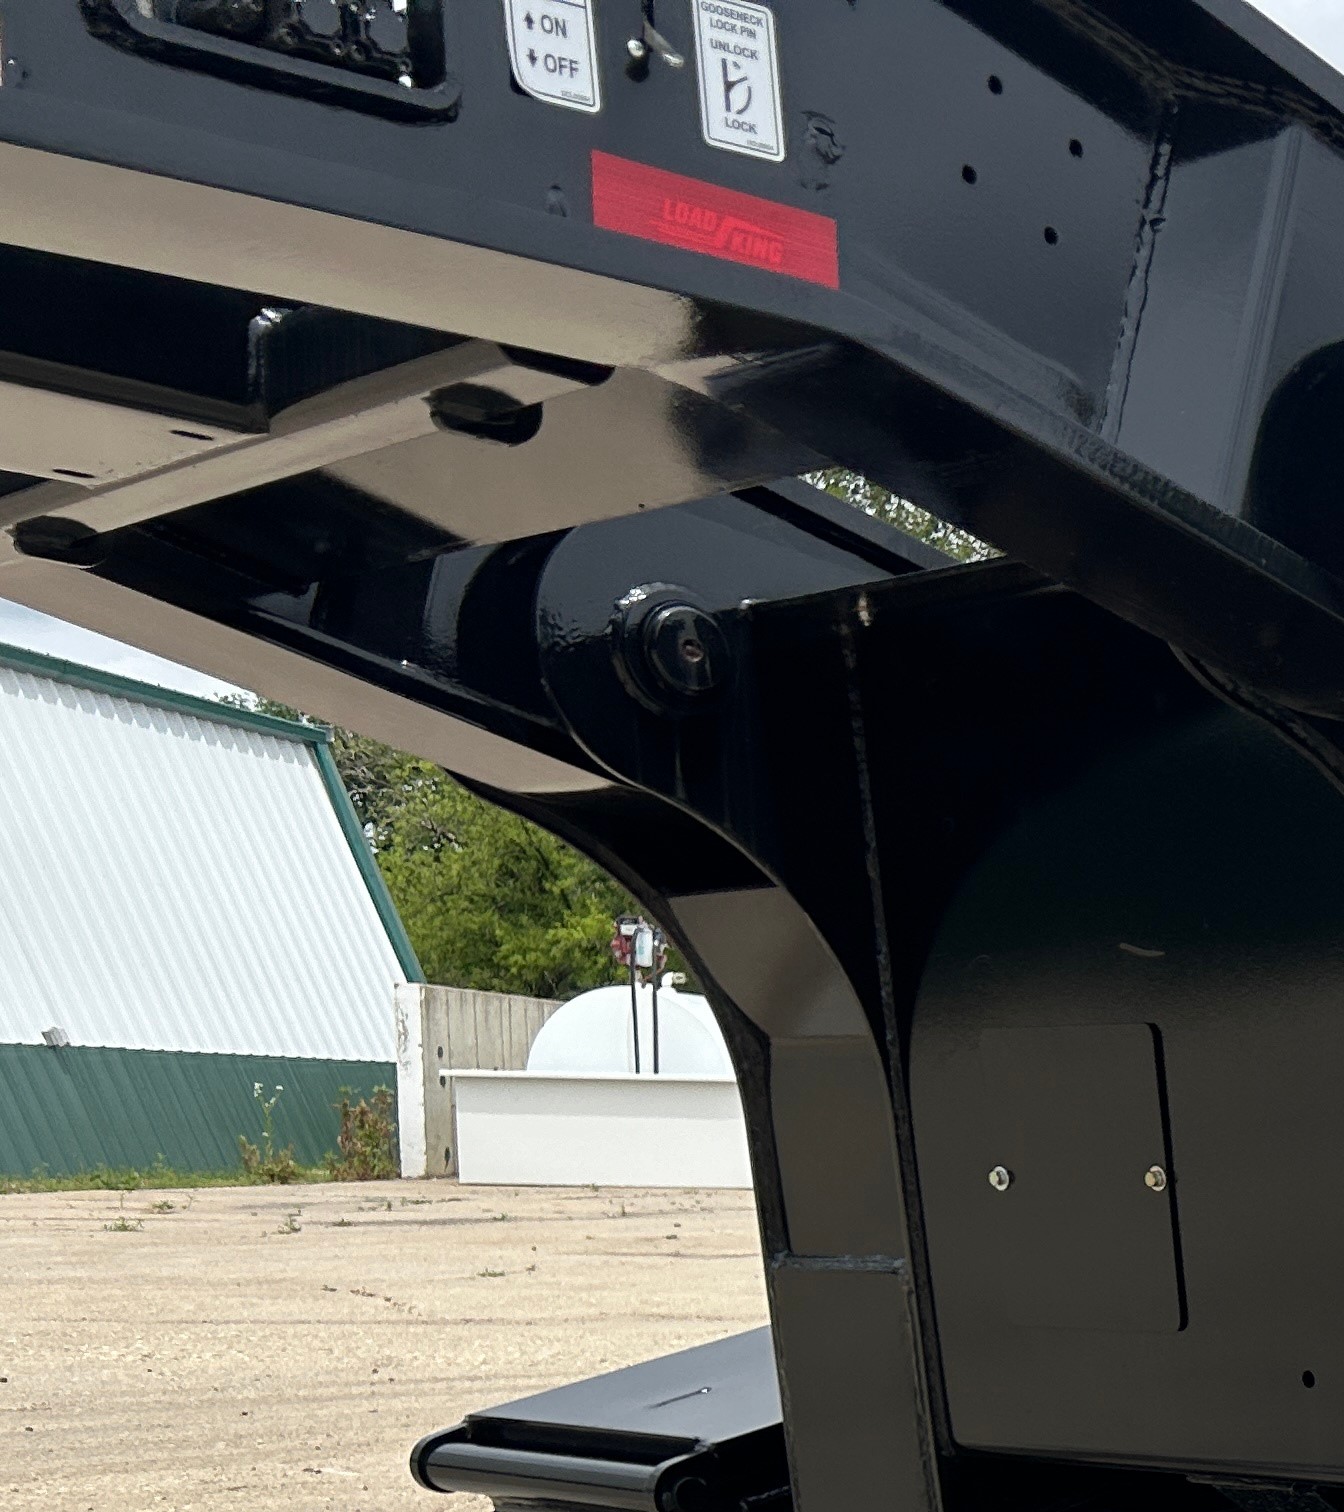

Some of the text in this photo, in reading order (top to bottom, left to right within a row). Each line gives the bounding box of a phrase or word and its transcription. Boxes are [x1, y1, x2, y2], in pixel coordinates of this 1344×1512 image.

[541, 15, 567, 38] ON
[701, 2, 764, 28] GOOSENECK
[709, 17, 757, 39] LOCK PIN
[708, 38, 758, 60] UNLOCK
[544, 54, 579, 78] OFF
[724, 117, 758, 134] LOCK
[662, 198, 717, 231] LOAD
[731, 232, 785, 265] KING
